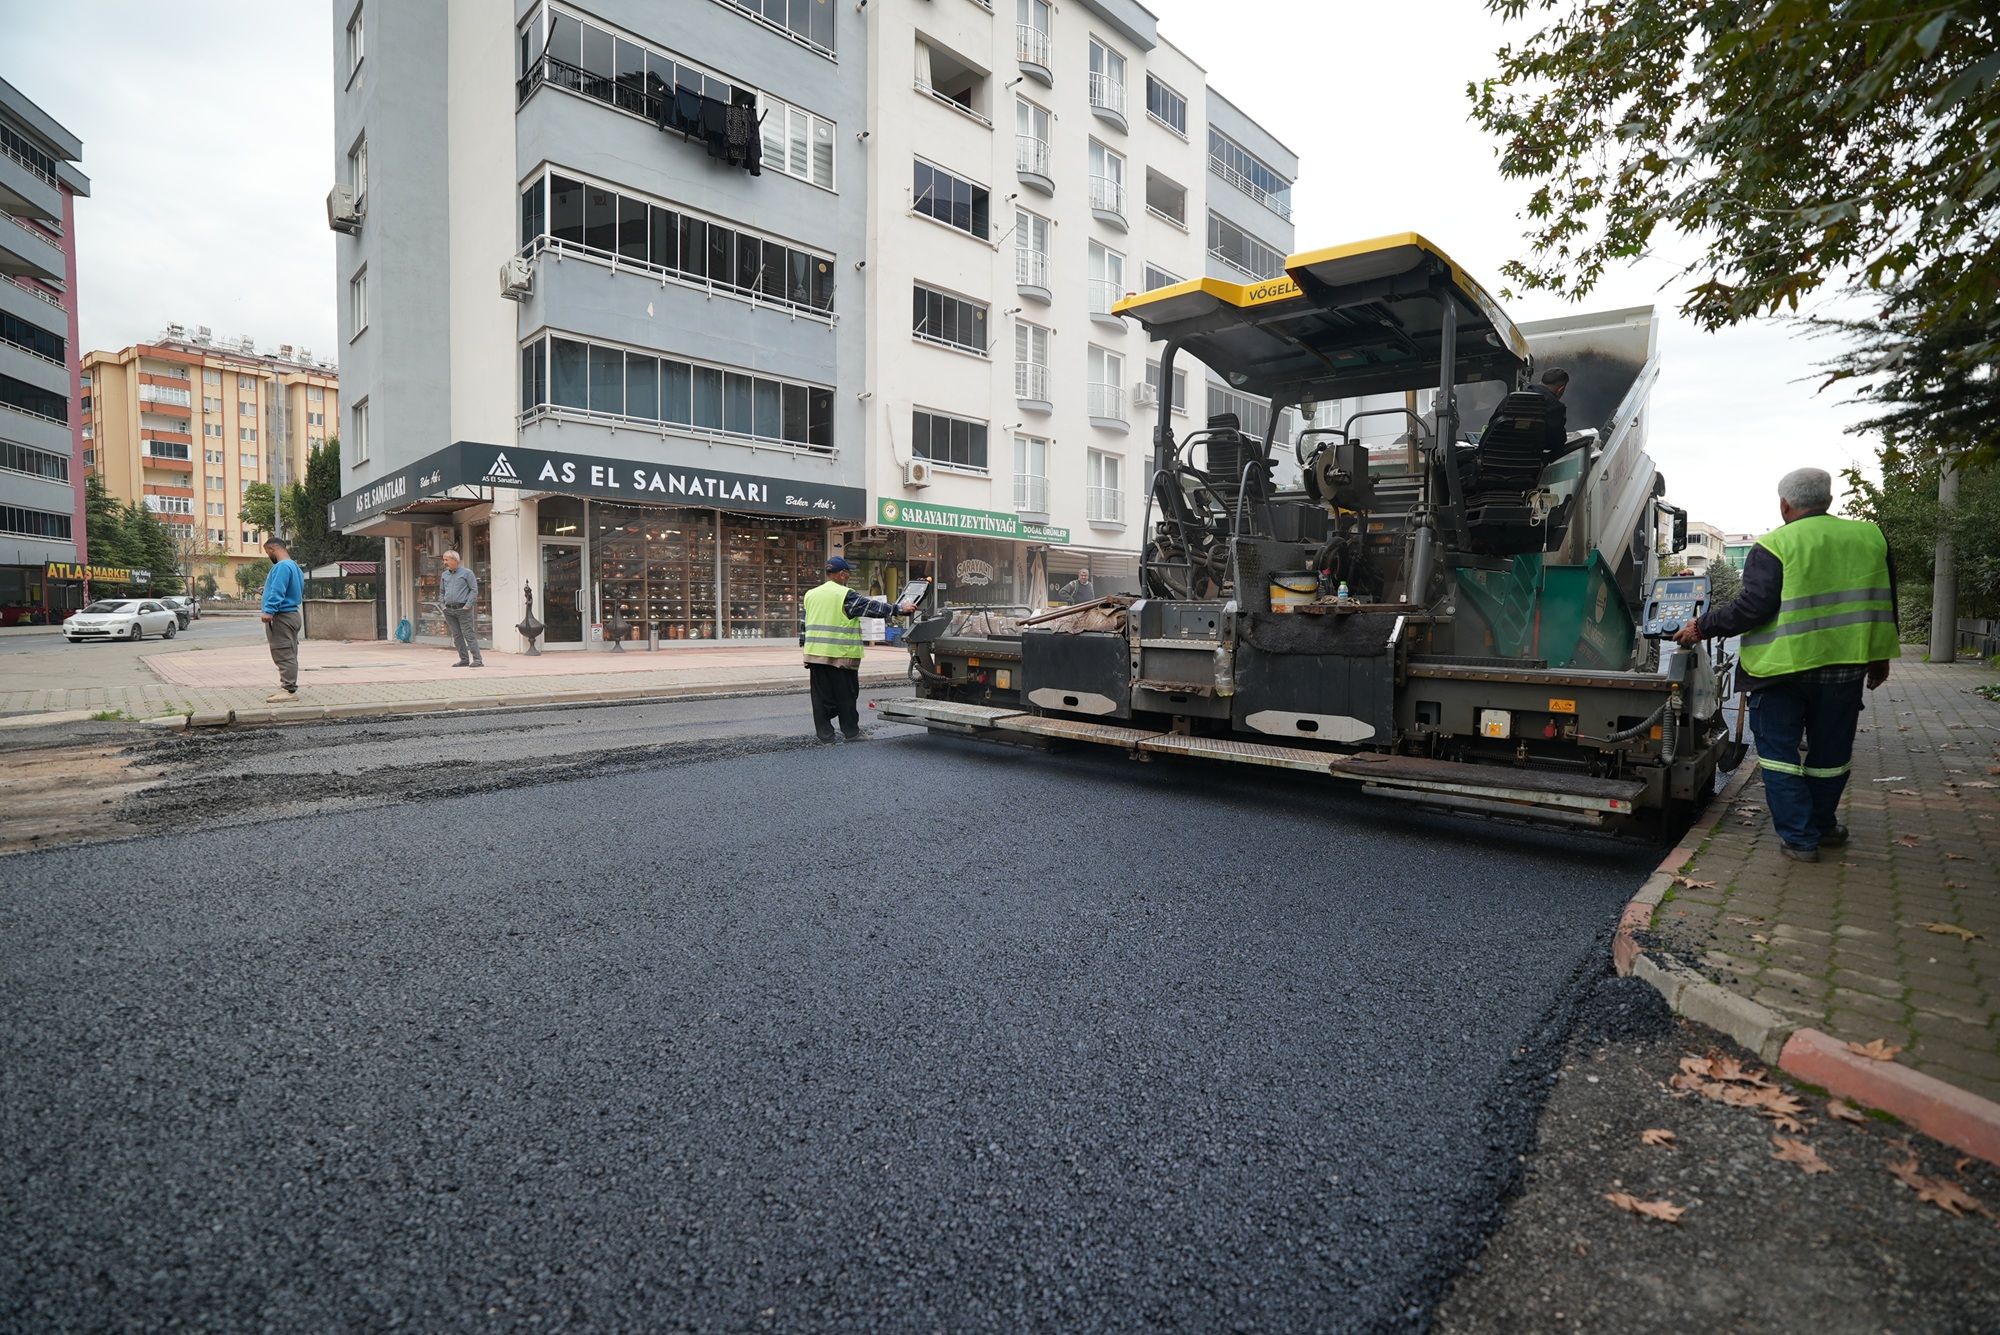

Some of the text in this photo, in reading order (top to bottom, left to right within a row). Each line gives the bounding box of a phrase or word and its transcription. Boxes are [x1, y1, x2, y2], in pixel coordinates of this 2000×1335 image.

[356, 475, 406, 513] AS EL SANATLARI
[538, 459, 768, 503] AS EL SANATLARI
[901, 507, 1017, 534] SARAYALTI ZEYTİNYAĞI
[1023, 525, 1042, 535] DOĞAL
[47, 563, 92, 580] ATLAS
[93, 567, 130, 578] MARKET
